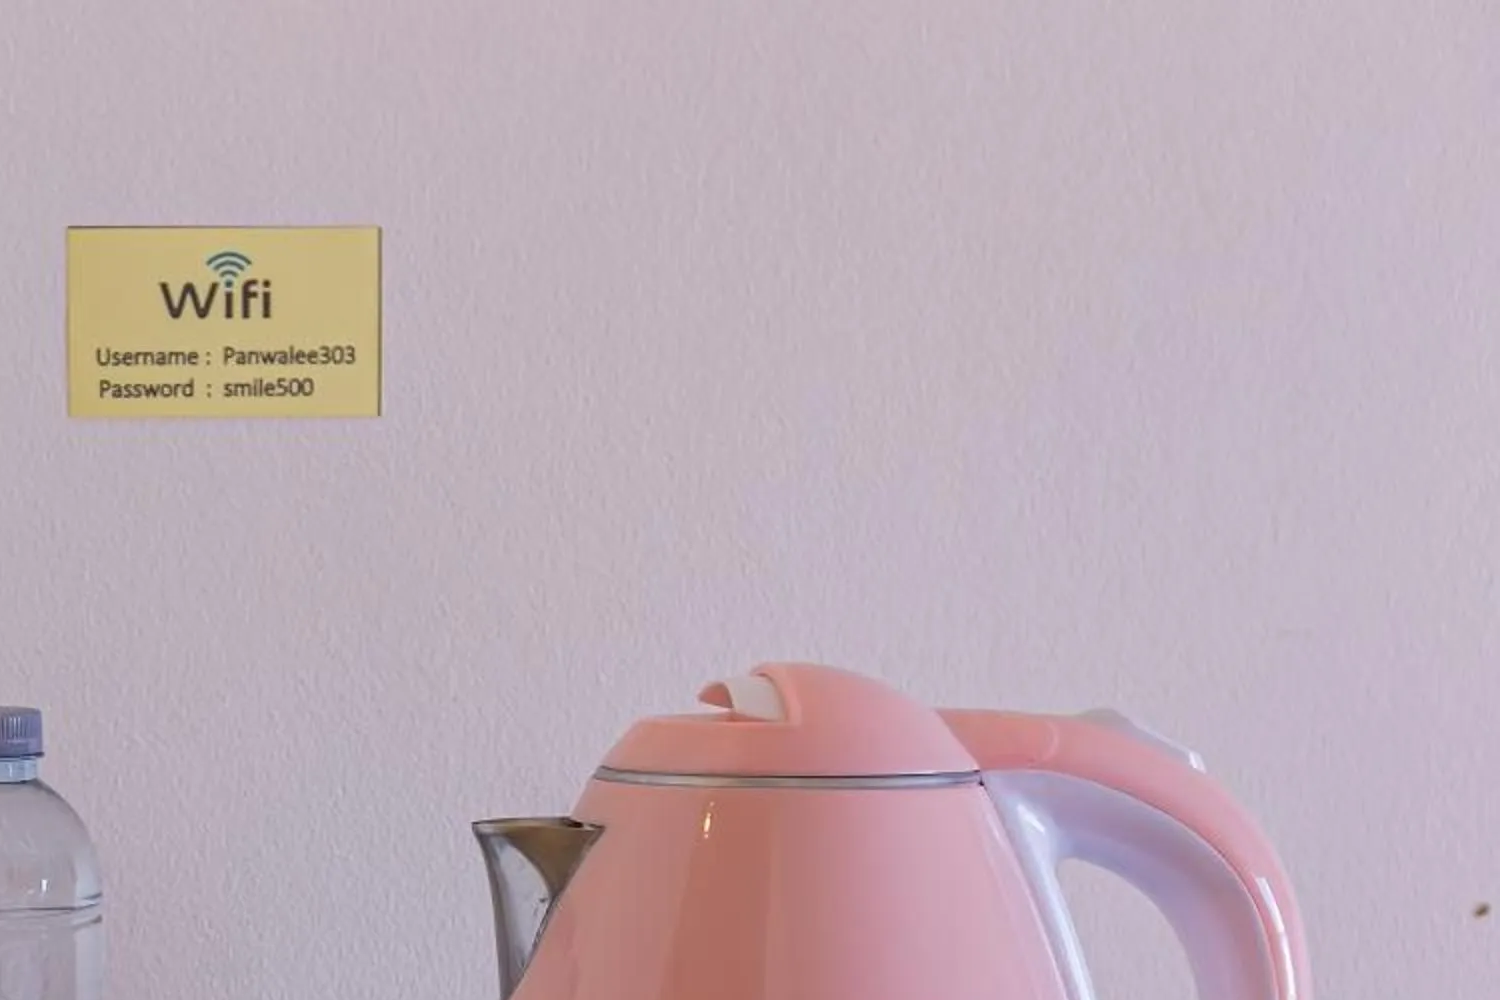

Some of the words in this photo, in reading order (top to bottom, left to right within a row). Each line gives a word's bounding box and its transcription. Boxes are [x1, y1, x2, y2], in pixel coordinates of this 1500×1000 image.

[159, 279, 272, 319] Wifi
[96, 347, 199, 367] Username
[223, 345, 356, 366] Panwalee303
[99, 378, 194, 398] Password
[223, 377, 314, 397] smile500
